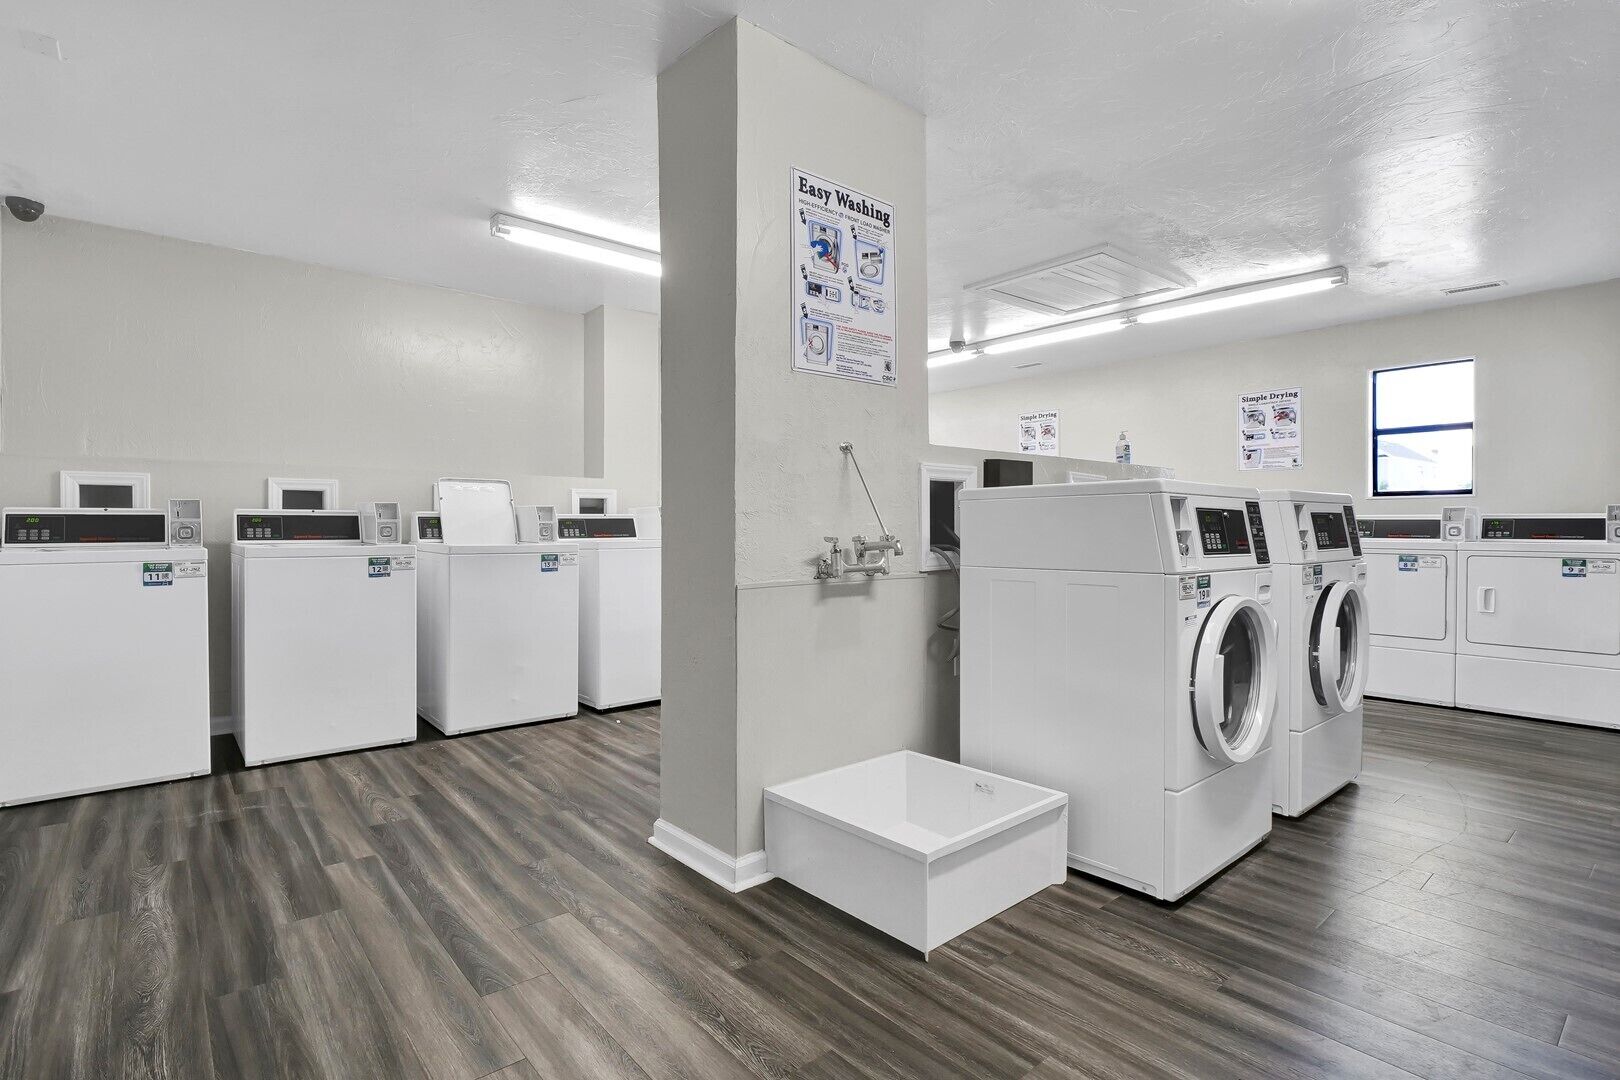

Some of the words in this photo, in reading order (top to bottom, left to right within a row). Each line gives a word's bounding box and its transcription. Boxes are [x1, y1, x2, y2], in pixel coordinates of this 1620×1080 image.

[798, 176, 832, 206] Easy
[834, 189, 890, 228] Washing
[1241, 395, 1268, 403] Simple
[1269, 391, 1299, 400] Drying
[1199, 590, 1206, 600] 19
